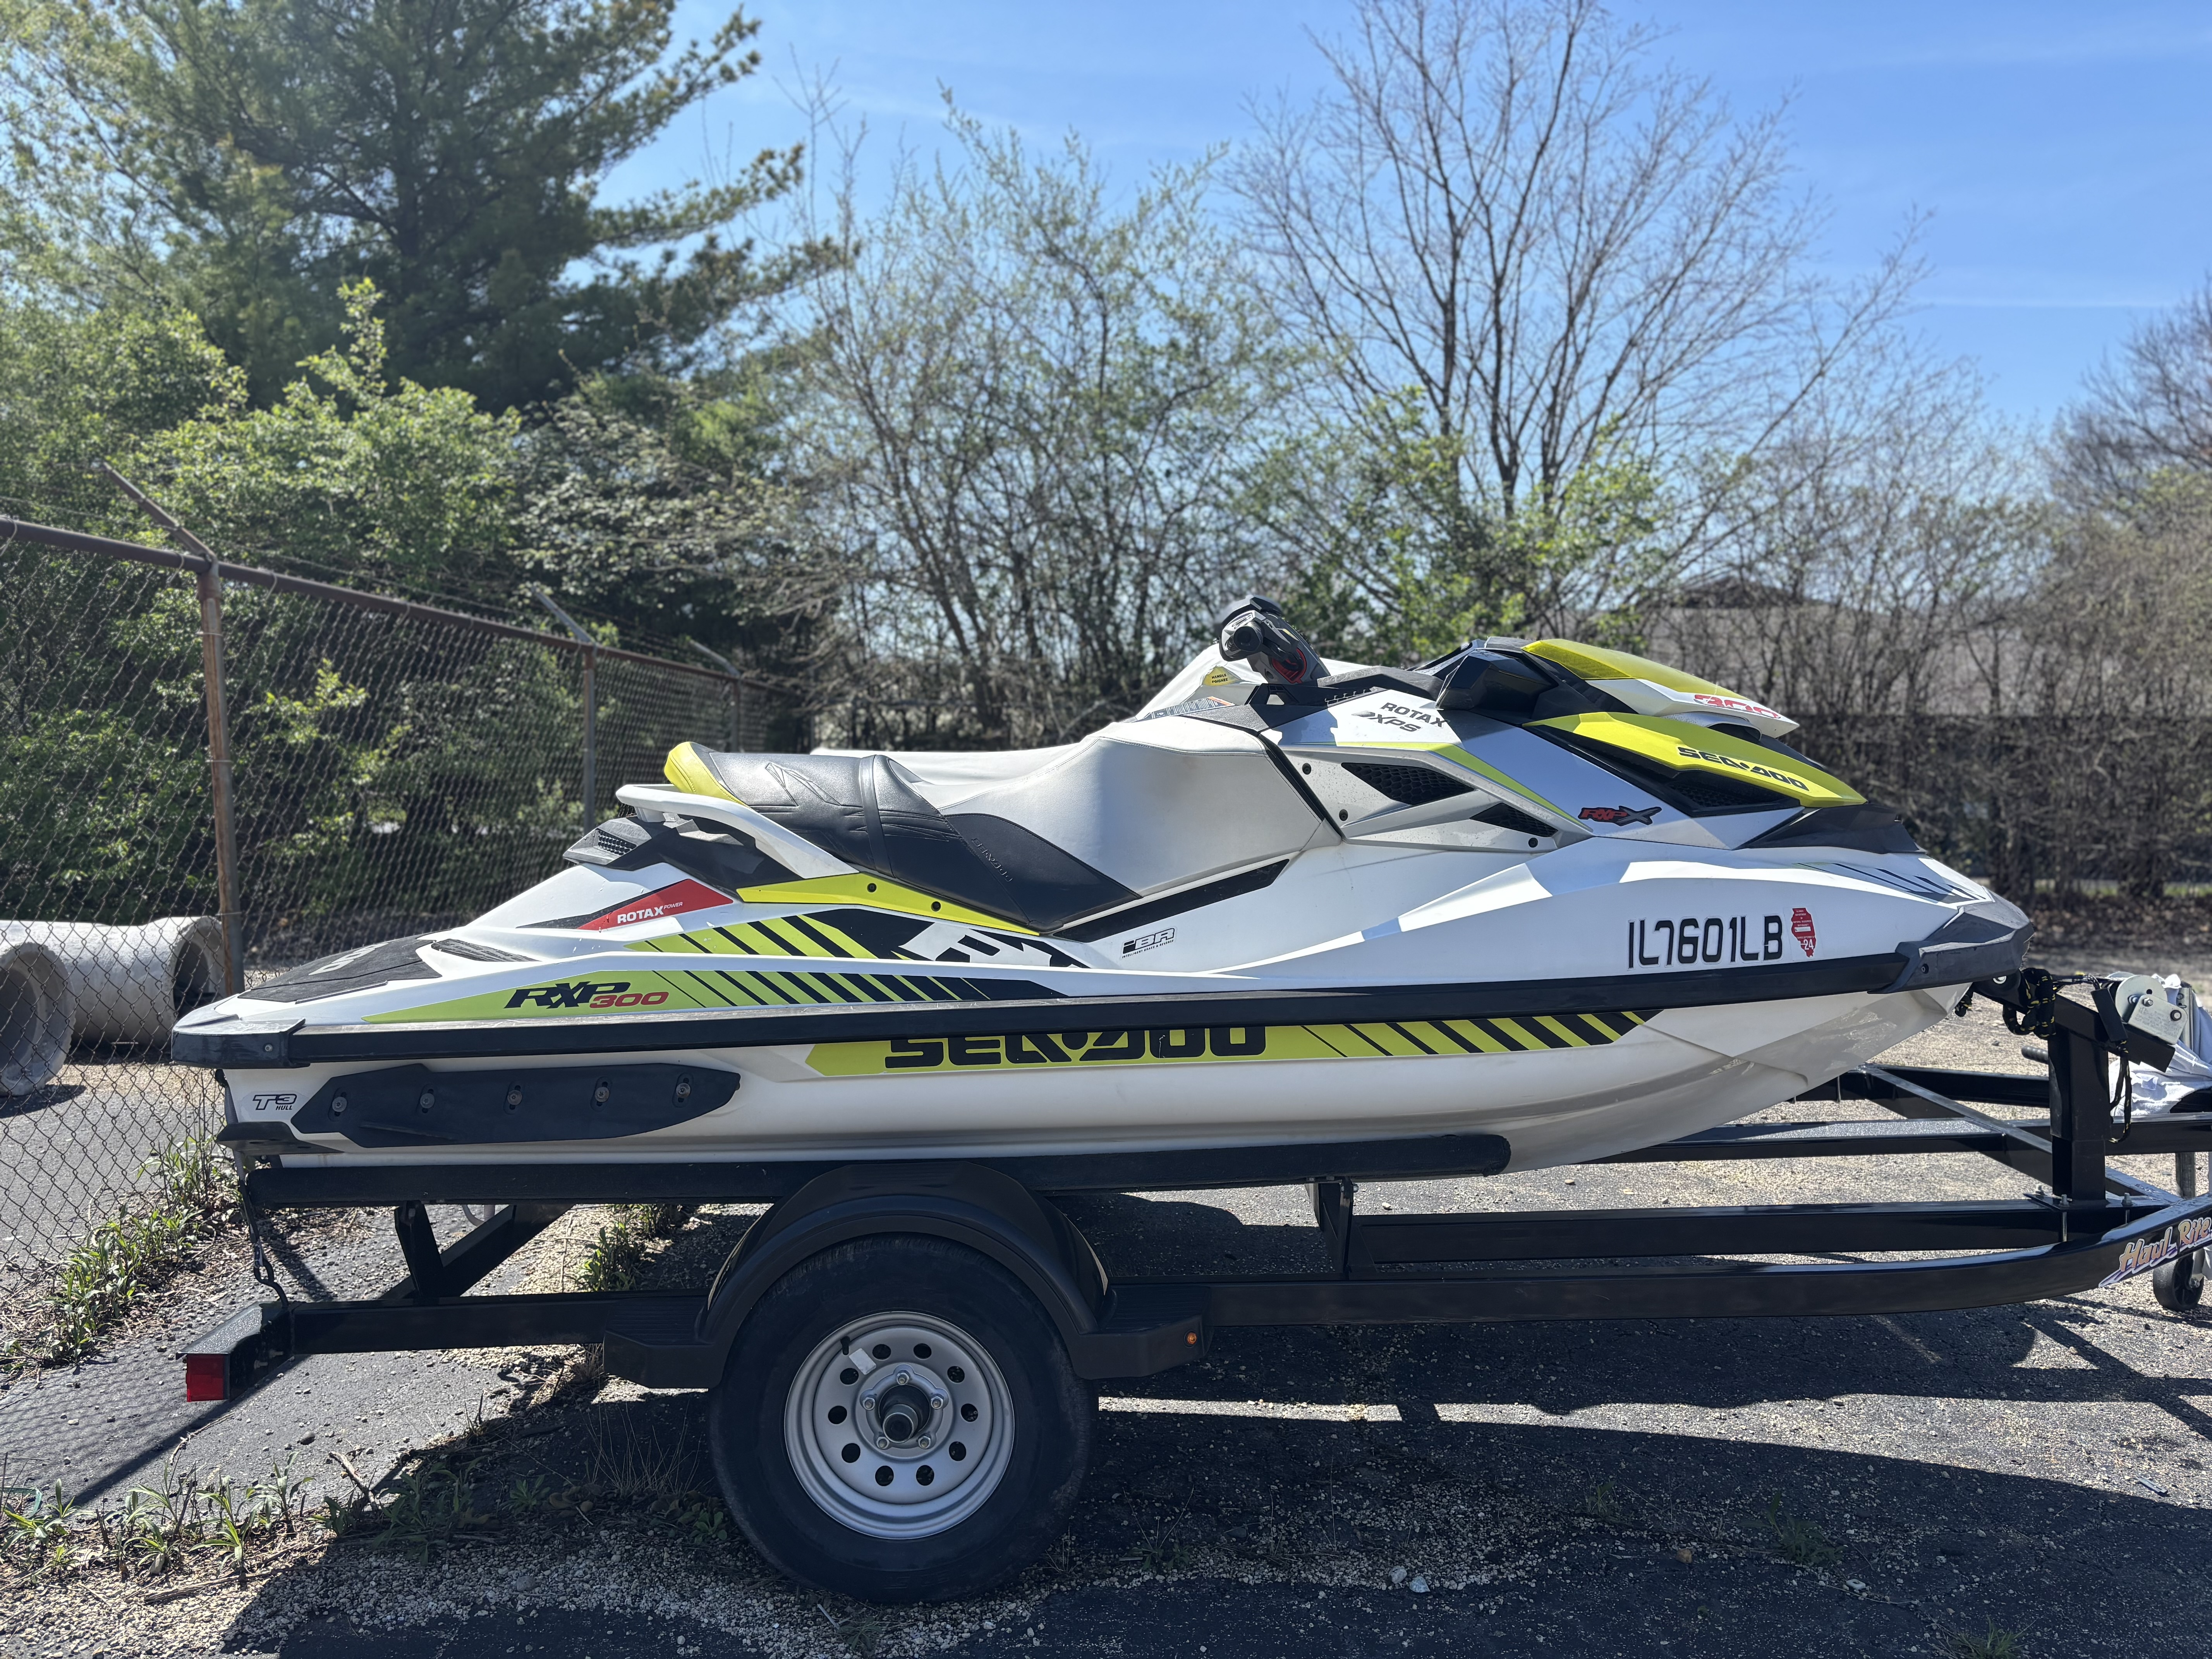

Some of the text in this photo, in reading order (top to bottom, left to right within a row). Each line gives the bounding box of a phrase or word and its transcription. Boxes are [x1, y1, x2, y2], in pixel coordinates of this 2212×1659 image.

[1367, 714, 1421, 732] XPS
[1381, 702, 1447, 727] ROTAX
[617, 905, 665, 924] ROTAX
[503, 981, 669, 1009] RXP 300
[252, 1094, 297, 1110] T3
[2119, 1217, 2212, 1272] Haul Rite
